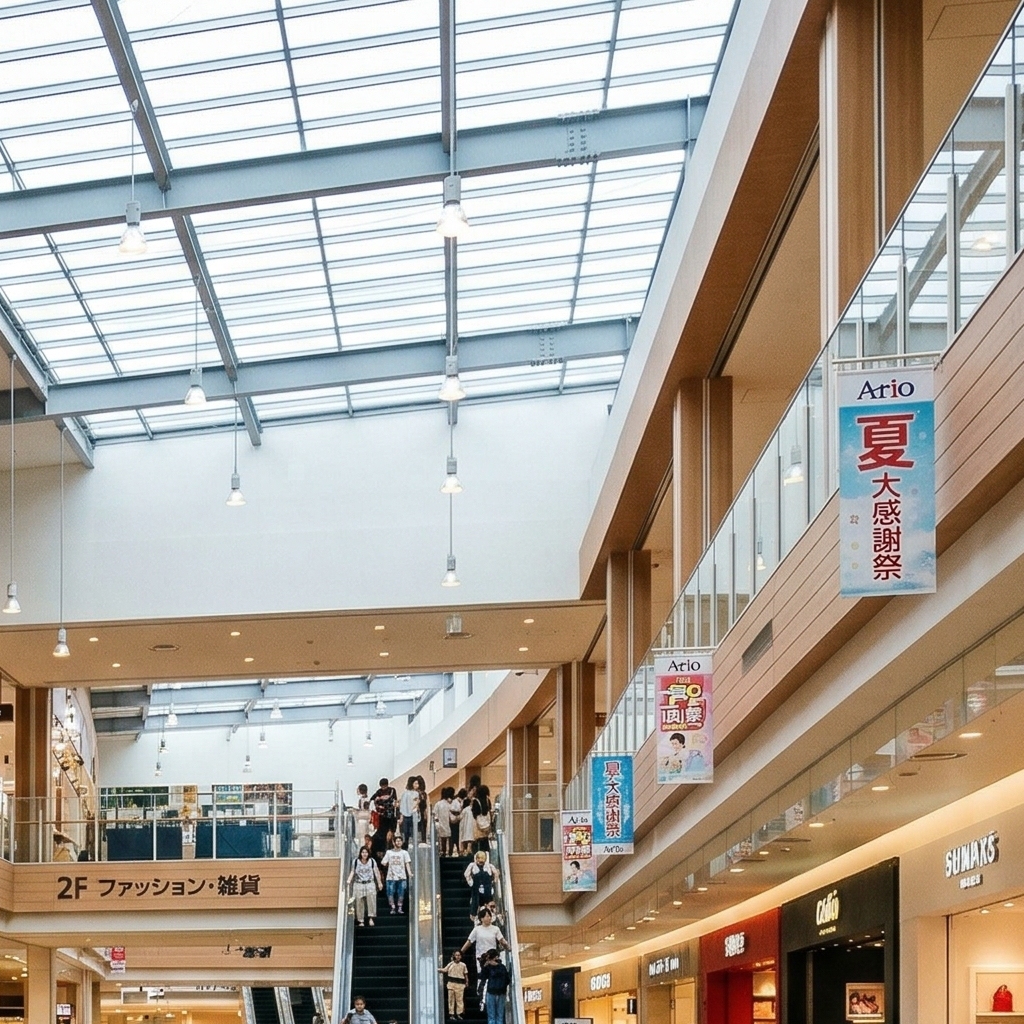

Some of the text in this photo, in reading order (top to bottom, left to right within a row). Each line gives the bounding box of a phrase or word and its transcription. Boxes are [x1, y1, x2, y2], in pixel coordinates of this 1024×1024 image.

[857, 379, 915, 400] Ario
[57, 874, 261, 900] 2F ファッション・雑貨
